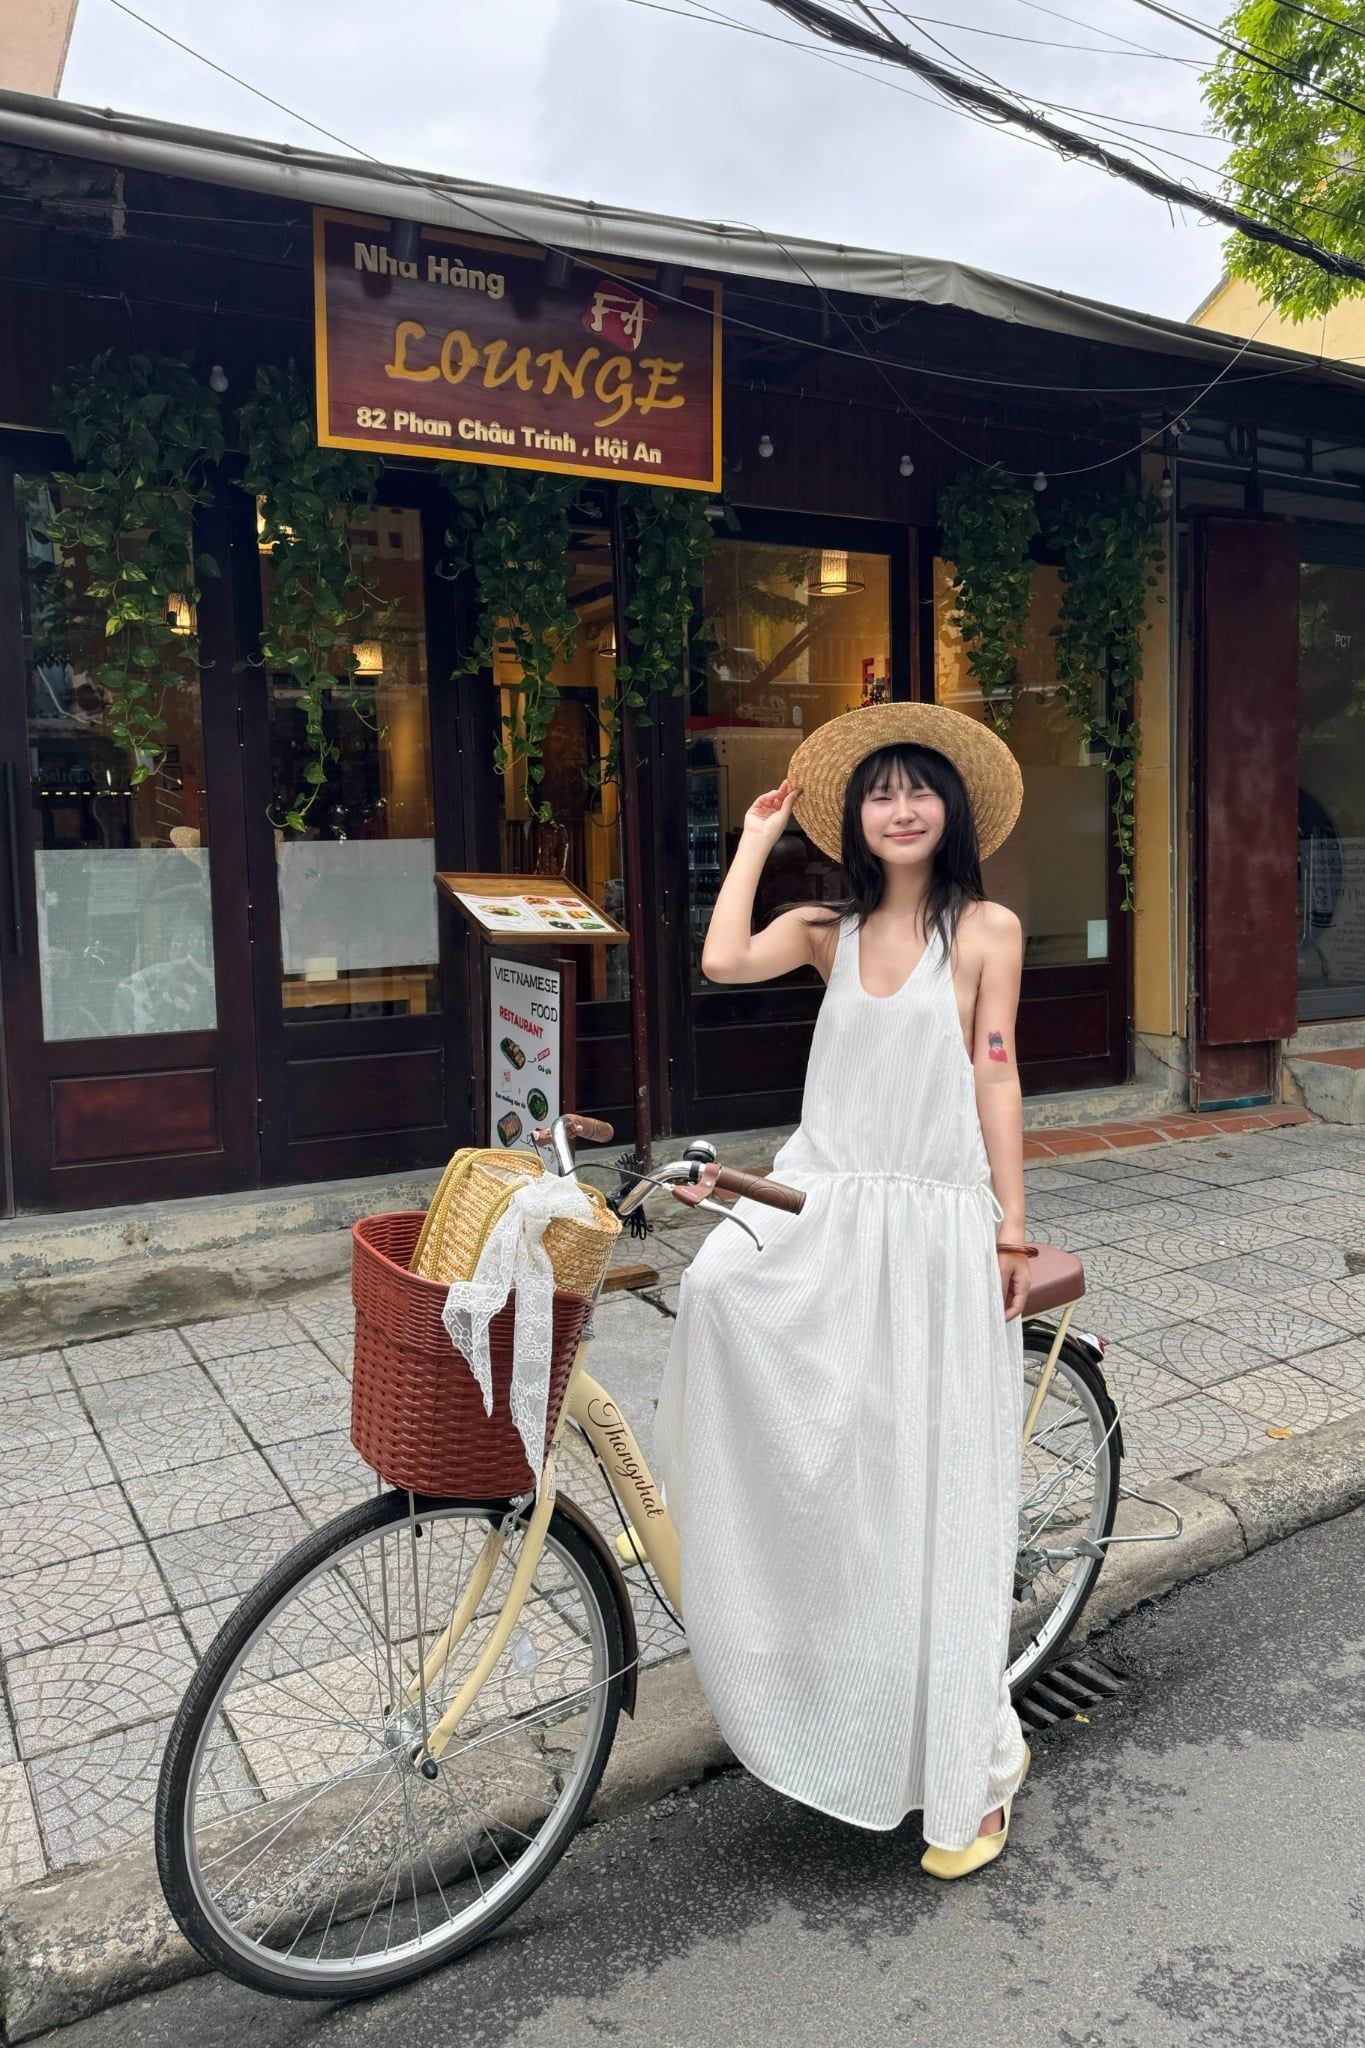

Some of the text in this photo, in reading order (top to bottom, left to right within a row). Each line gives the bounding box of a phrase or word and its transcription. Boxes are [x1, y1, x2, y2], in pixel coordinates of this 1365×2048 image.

[427, 255, 505, 299] Hàng
[590, 292, 653, 350] FA
[384, 320, 685, 428] LOUNGE
[356, 406, 388, 430] 82
[394, 409, 452, 437] Phan
[458, 417, 515, 445] Châu
[521, 426, 576, 453] Trinh
[595, 435, 628, 464] Hội
[633, 441, 662, 464] An
[494, 966, 559, 995] VIETNAMESE
[499, 1005, 544, 1040] RESTAURANT
[531, 1002, 558, 1022] FOOD
[587, 1398, 665, 1519] Thongnhat
